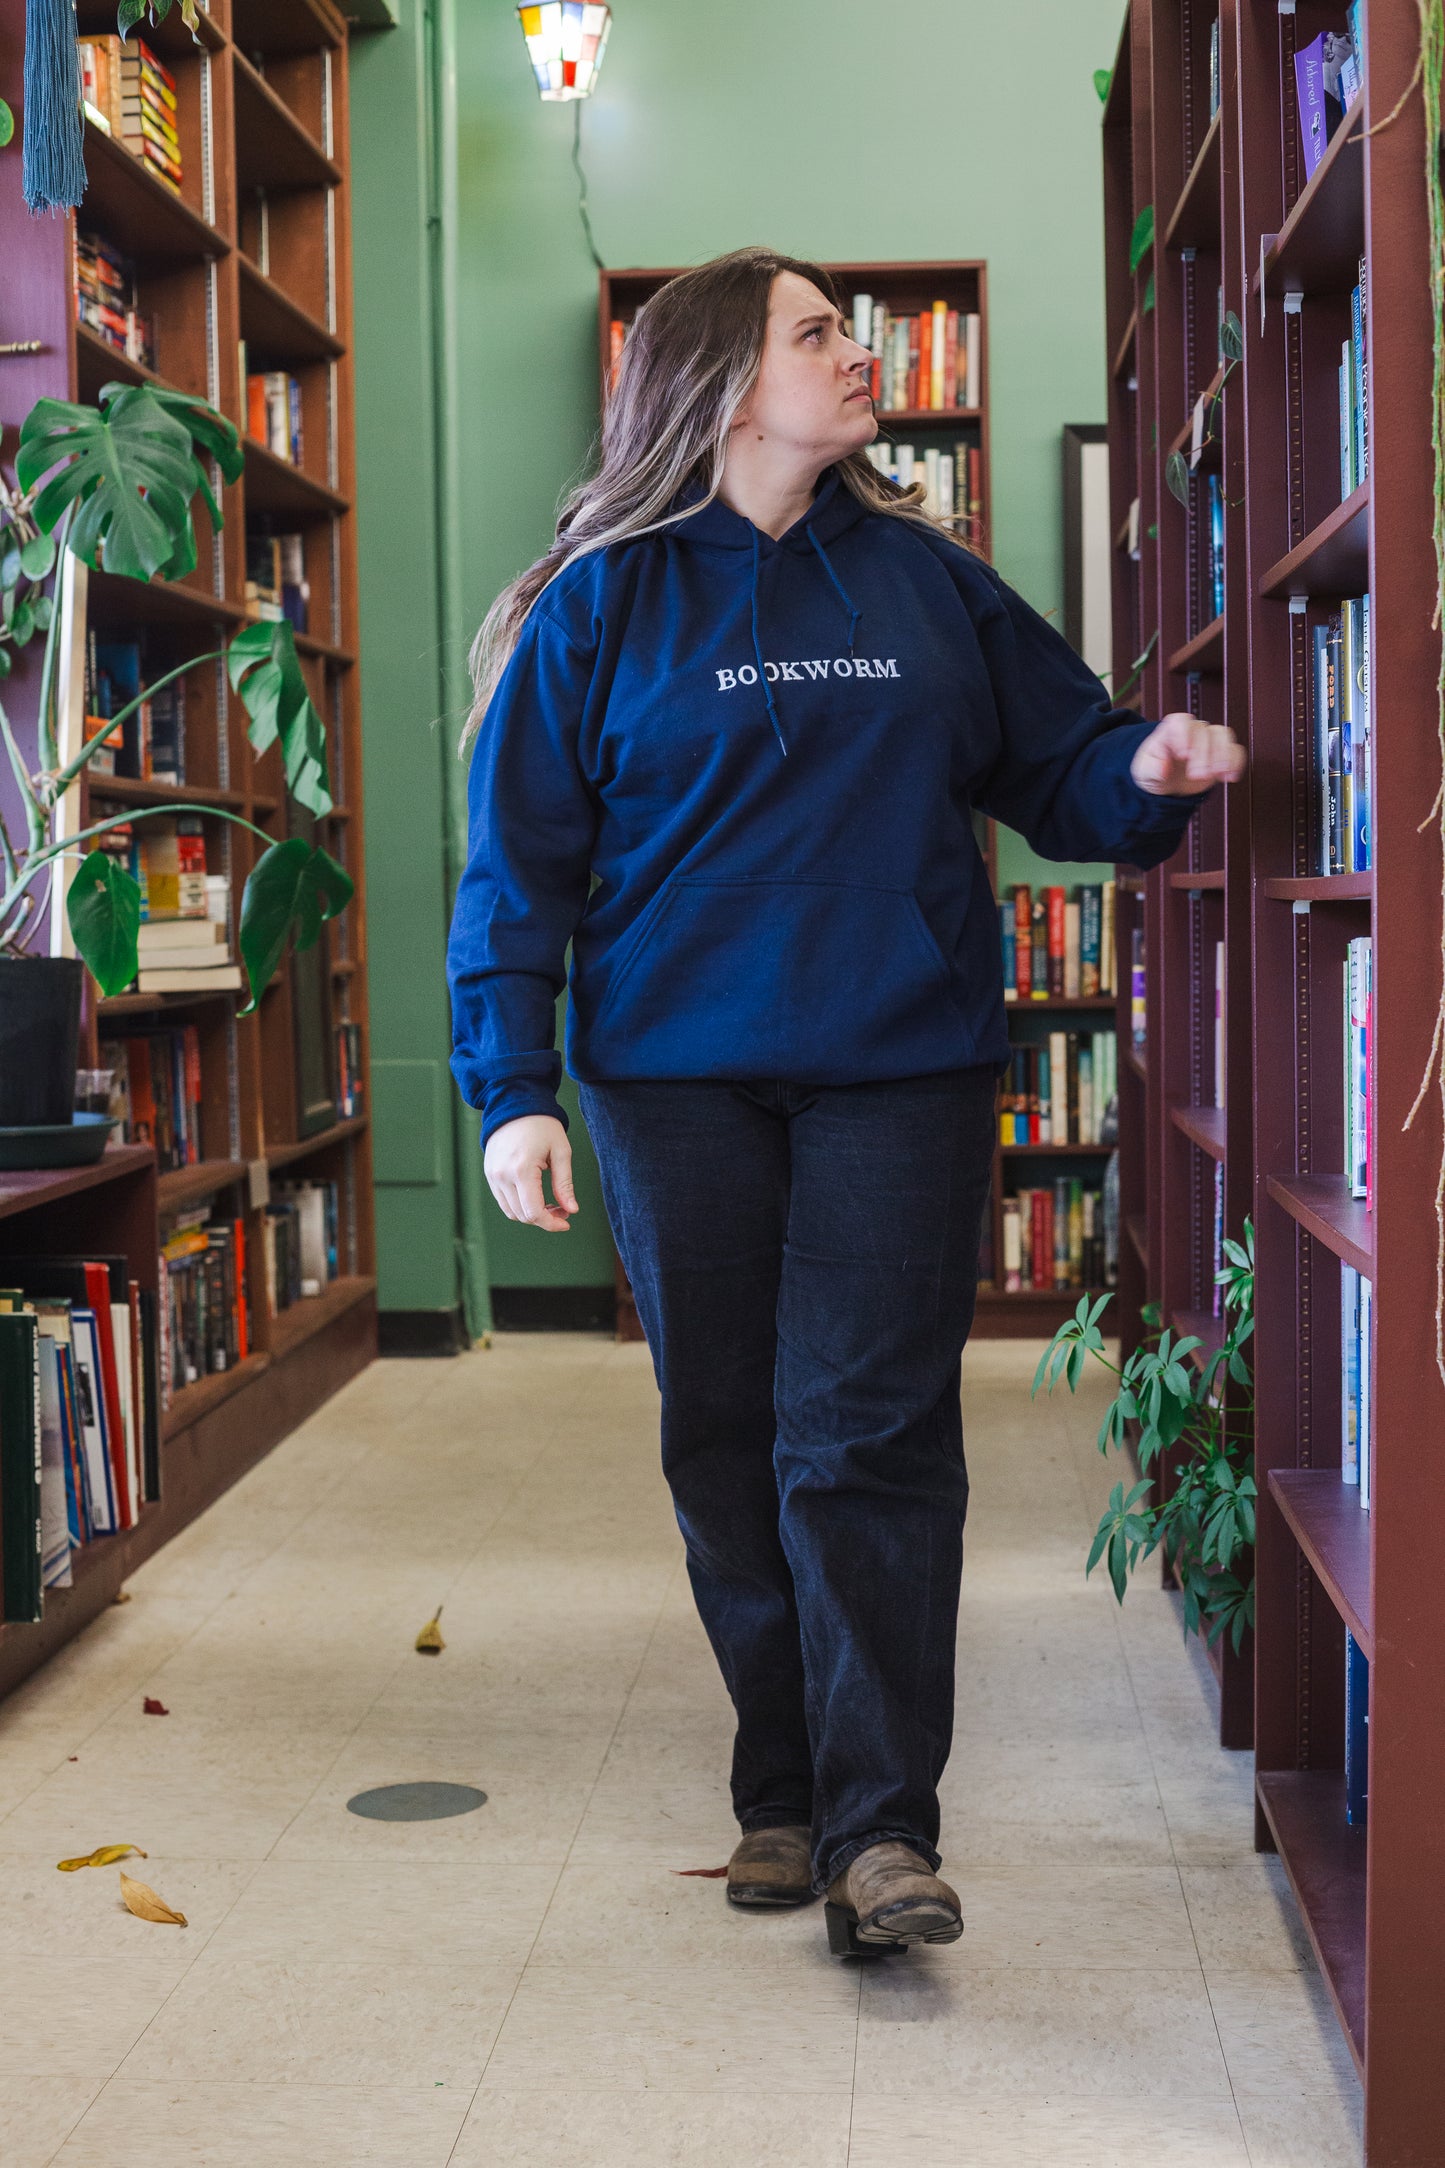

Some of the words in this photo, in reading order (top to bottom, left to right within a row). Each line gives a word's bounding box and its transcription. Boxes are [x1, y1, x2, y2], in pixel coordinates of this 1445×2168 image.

[1305, 55, 1321, 106] Adored
[1313, 136, 1322, 162] TILLY
[715, 658, 901, 692] BOOKWORM
